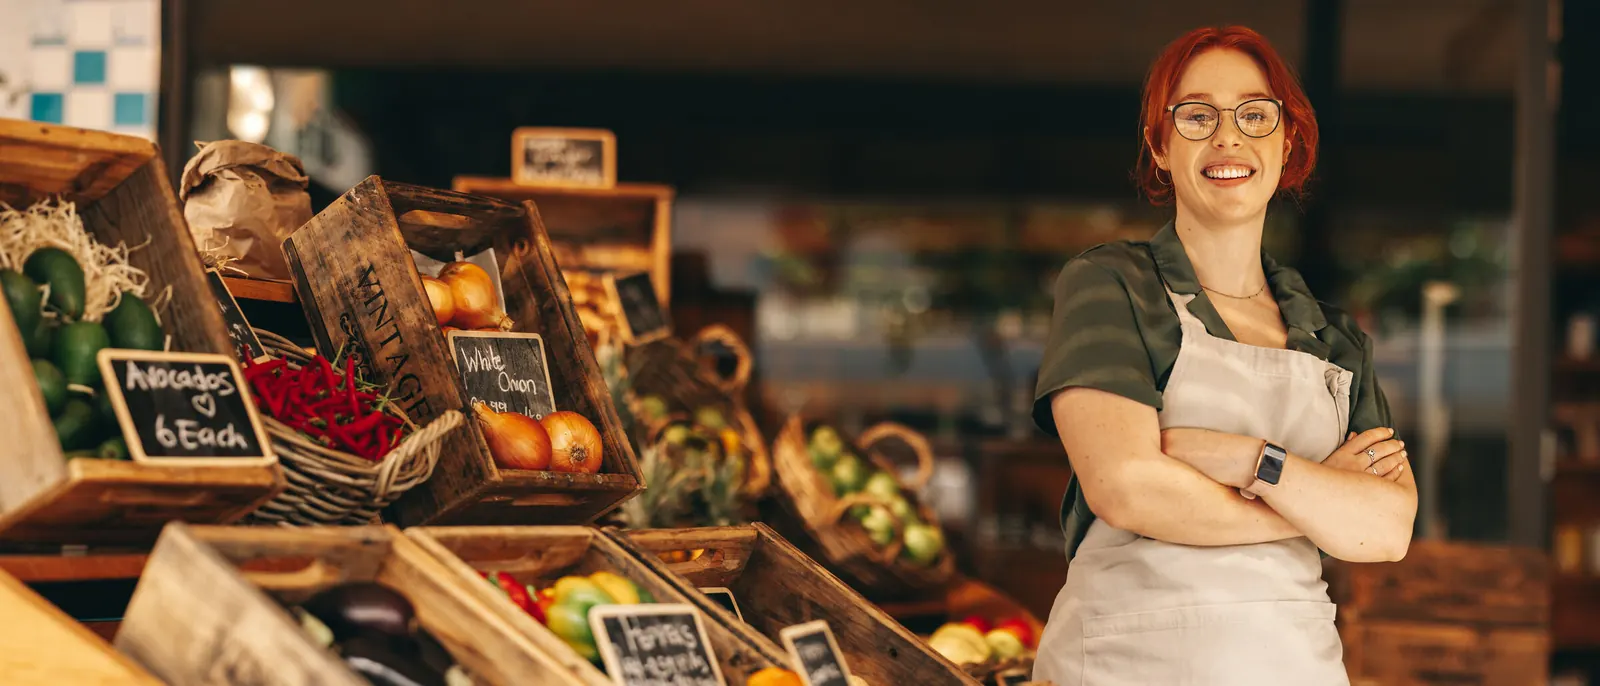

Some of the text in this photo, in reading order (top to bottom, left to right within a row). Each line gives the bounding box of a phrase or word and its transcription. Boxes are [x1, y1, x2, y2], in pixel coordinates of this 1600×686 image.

[358, 264, 433, 419] VINTAGE
[461, 345, 505, 372] White
[126, 360, 235, 396] Avocados
[498, 371, 537, 395] Onion
